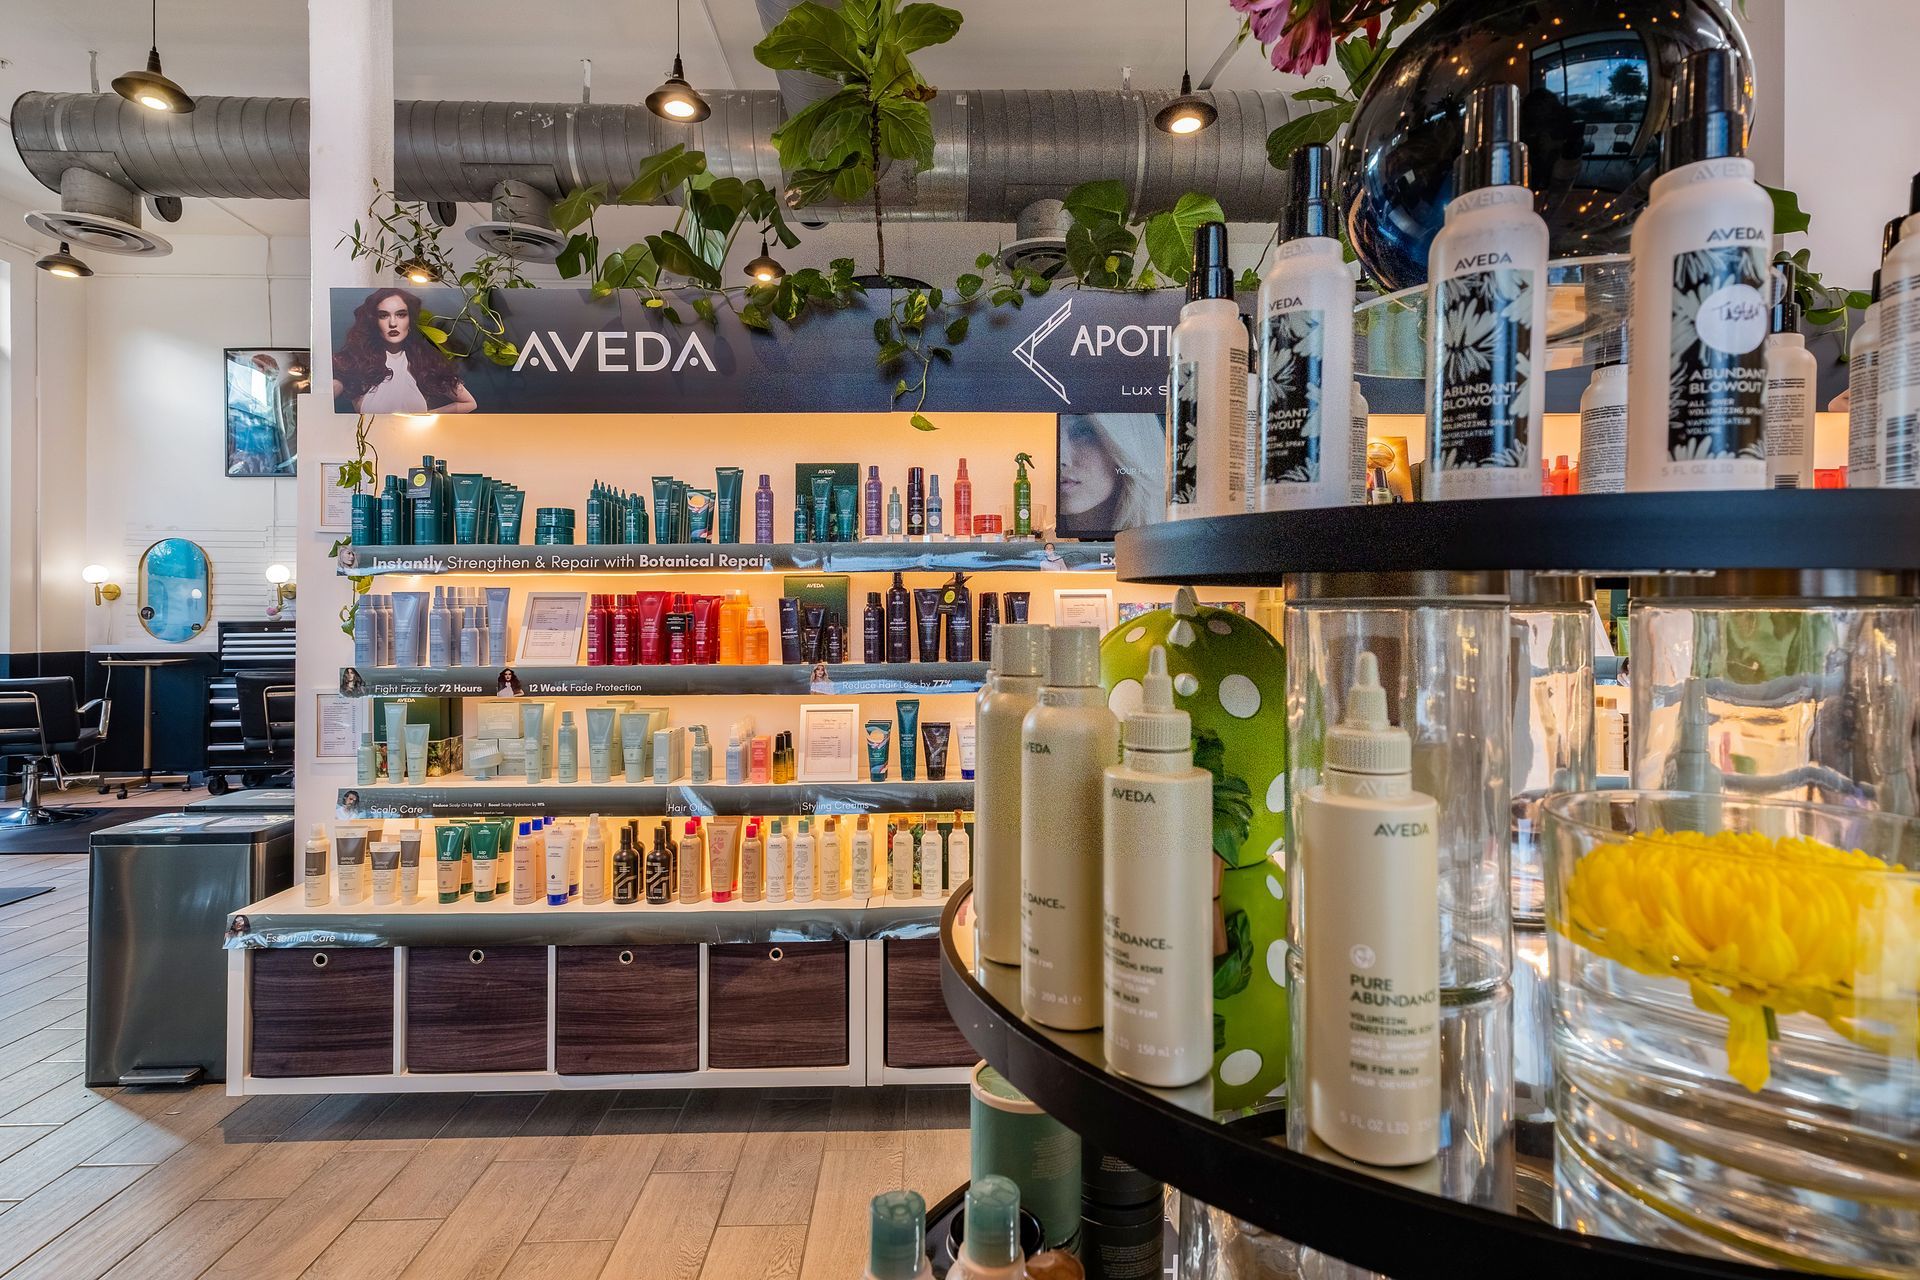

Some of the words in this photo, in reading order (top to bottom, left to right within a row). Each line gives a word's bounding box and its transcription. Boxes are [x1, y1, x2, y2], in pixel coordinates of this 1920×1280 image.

[1707, 227, 1765, 242] AVEDA
[1455, 252, 1512, 271] AVEDA
[1269, 297, 1303, 312] VEDA
[512, 331, 717, 372] AVEDA
[1689, 367, 1766, 382] ABUNDANT
[1121, 385, 1153, 396] Lux
[1444, 381, 1517, 398] ABUNDANT
[1689, 380, 1762, 395] BLOWOUT
[1443, 395, 1511, 410] BLOWOUT
[1688, 407, 1744, 417] VOLUMIZING
[1115, 467, 1137, 475] YOUR
[373, 556, 443, 573] Instantly
[447, 555, 530, 573] Strengthen
[534, 556, 546, 569] &
[551, 556, 600, 572] Repair
[604, 553, 634, 568] with
[639, 553, 715, 568] Botanical
[718, 553, 771, 571] Repair
[375, 684, 398, 695] Fight
[400, 684, 422, 693] Frizz
[424, 683, 437, 692] for
[439, 684, 452, 693] 72
[453, 684, 483, 693] Hours
[528, 684, 538, 692] 12
[540, 684, 568, 692] Week
[570, 683, 593, 692] Fade
[595, 683, 642, 692] Protection
[842, 681, 876, 690] Reduce
[878, 680, 897, 689] Hair
[899, 680, 918, 689] Loss
[920, 680, 931, 691] by
[932, 679, 952, 688] 77%
[1112, 787, 1156, 804] AVEDA
[370, 804, 398, 813] Scalp
[400, 804, 424, 813] Care
[668, 803, 687, 812] Hair
[689, 803, 706, 812] Oils
[802, 801, 832, 815] Styling
[834, 800, 869, 810] Creams
[1374, 823, 1430, 837] AVEDA
[266, 934, 308, 942] Essential
[311, 934, 336, 942] Care
[1350, 974, 1392, 991] PURE
[1350, 991, 1436, 1007] ABUNDANC
